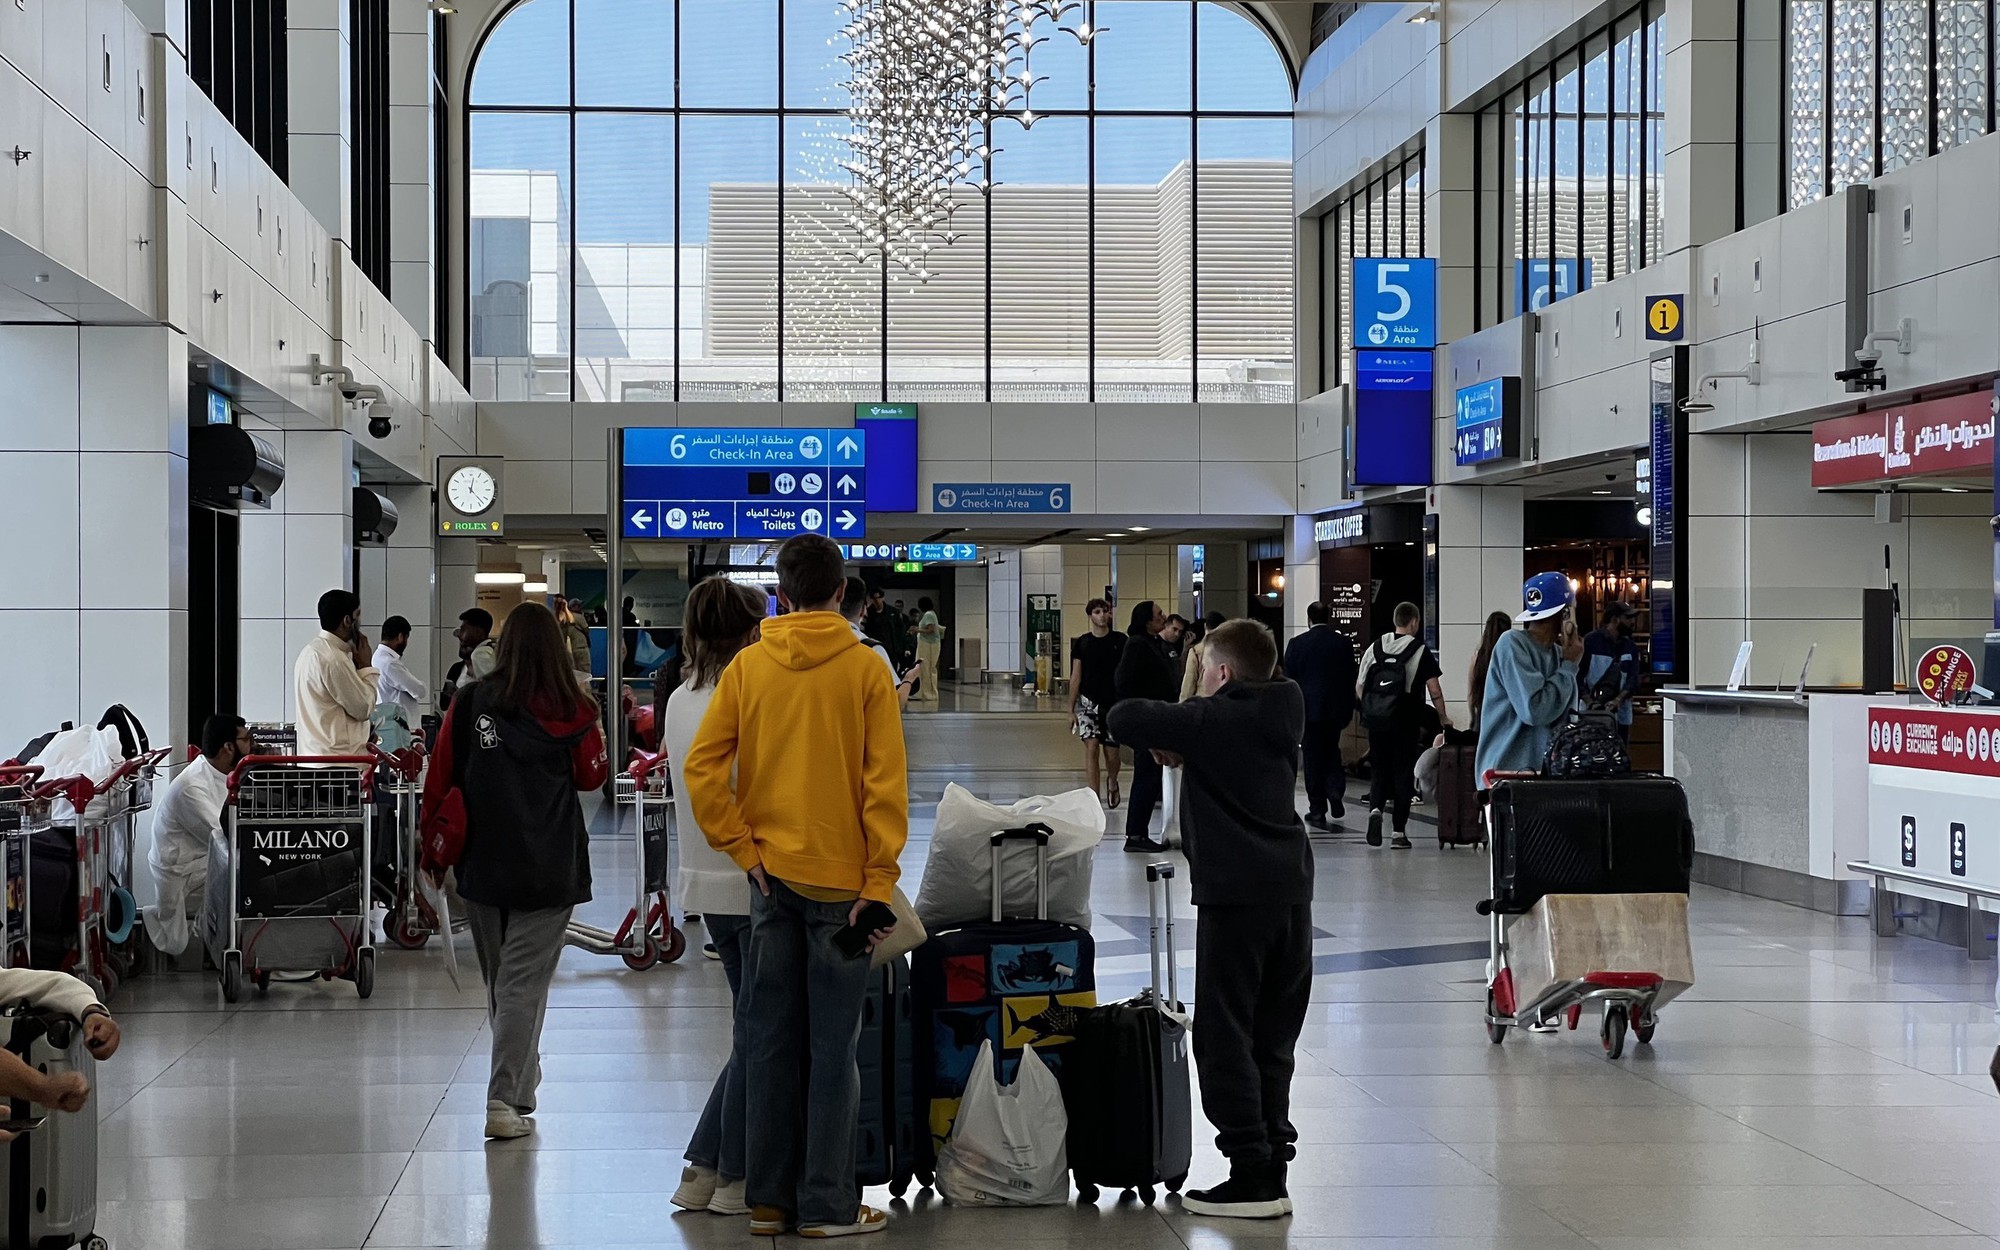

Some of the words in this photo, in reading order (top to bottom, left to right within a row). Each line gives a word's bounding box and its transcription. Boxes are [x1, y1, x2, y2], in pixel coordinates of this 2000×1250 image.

[1377, 264, 1411, 321] 5
[1393, 325, 1419, 333] منطقة
[1393, 335, 1416, 344] Area
[1490, 386, 1494, 412] 5
[691, 434, 721, 447] السفر
[723, 434, 759, 447] إجراءات
[761, 435, 794, 445] منطقة
[670, 434, 687, 459] 6
[709, 449, 761, 460] Check-In
[765, 449, 794, 460] Area
[961, 488, 985, 497] السفر
[986, 488, 1015, 498] إجراءات
[1017, 488, 1044, 496] منطقة
[961, 499, 1003, 508] Check-In
[1006, 499, 1030, 508] Area
[1049, 488, 1064, 509] 6
[692, 509, 710, 518] مترو
[746, 508, 769, 518] المياه
[771, 509, 796, 518] دورات
[455, 522, 487, 530] ROLEX
[693, 520, 724, 530] Metro
[762, 520, 796, 530] Toilets
[1315, 517, 1343, 542] STARBUCKS
[1343, 514, 1363, 538] COFFEE
[913, 545, 921, 558] 6
[1906, 723, 1938, 739] CURRENCY
[1906, 738, 1938, 755] EXCHANGE
[252, 830, 349, 849] MILANO
